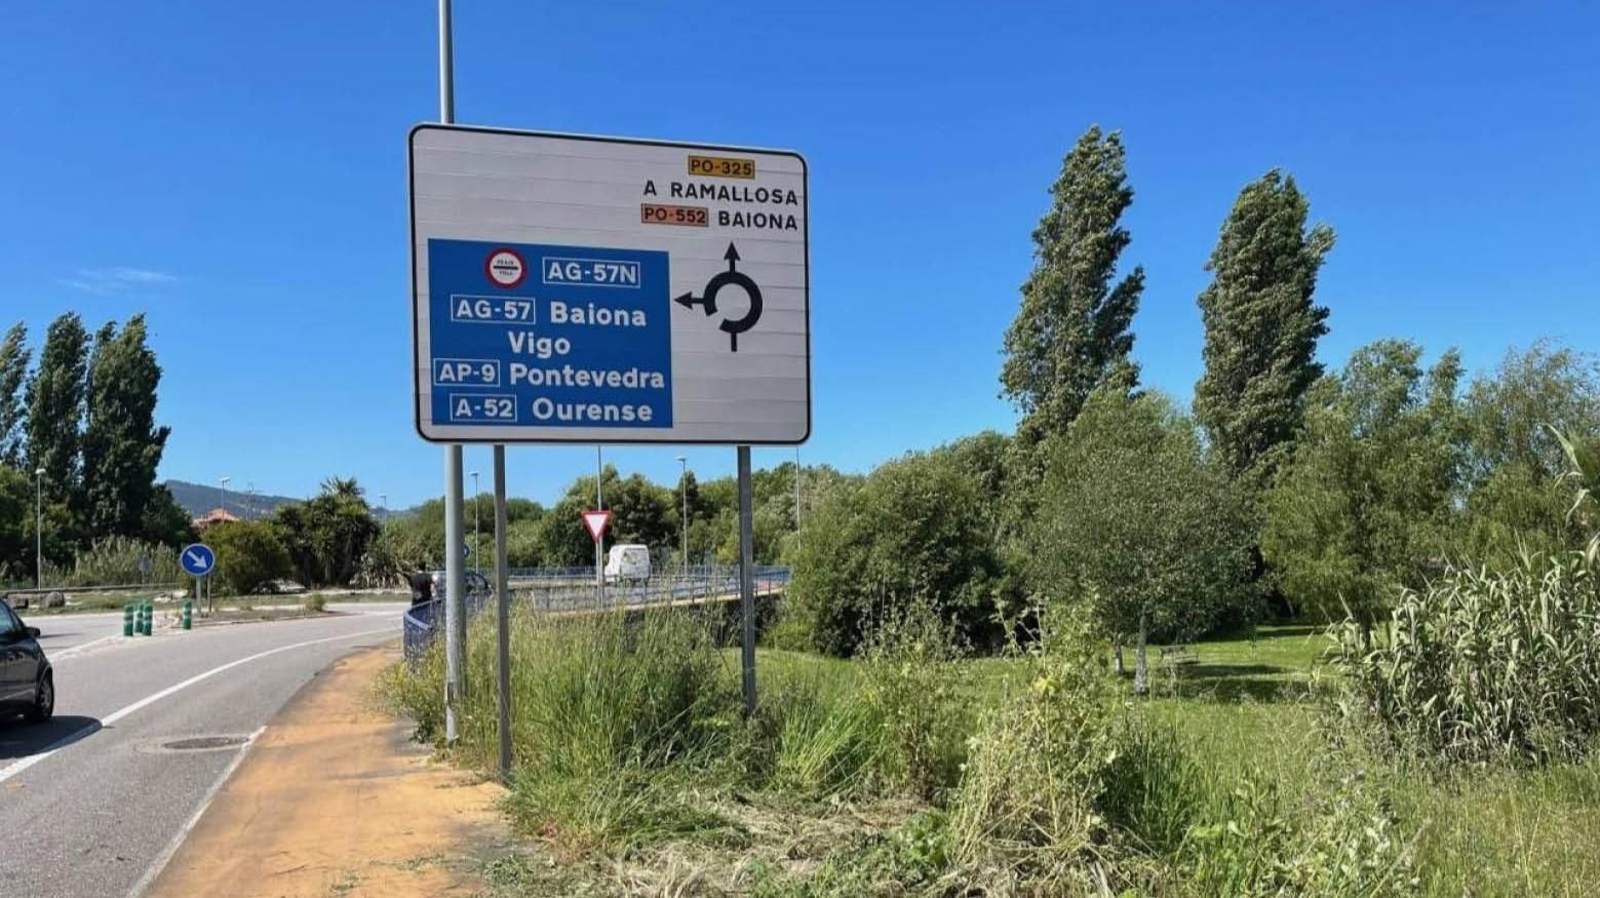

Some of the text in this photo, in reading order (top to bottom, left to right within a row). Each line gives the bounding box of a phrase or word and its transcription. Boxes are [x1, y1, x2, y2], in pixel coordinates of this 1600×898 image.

[691, 159, 751, 175] PO-325
[644, 180, 798, 205] A RAMALLOSA
[644, 207, 797, 230] PO-552 BAIONA
[548, 262, 637, 284] AG-57N
[456, 299, 646, 326] AG-57 Baiona
[508, 331, 571, 358] Vigo
[439, 363, 665, 388] AP-9 Pontevedra
[455, 397, 653, 422] A-52 Ourense
